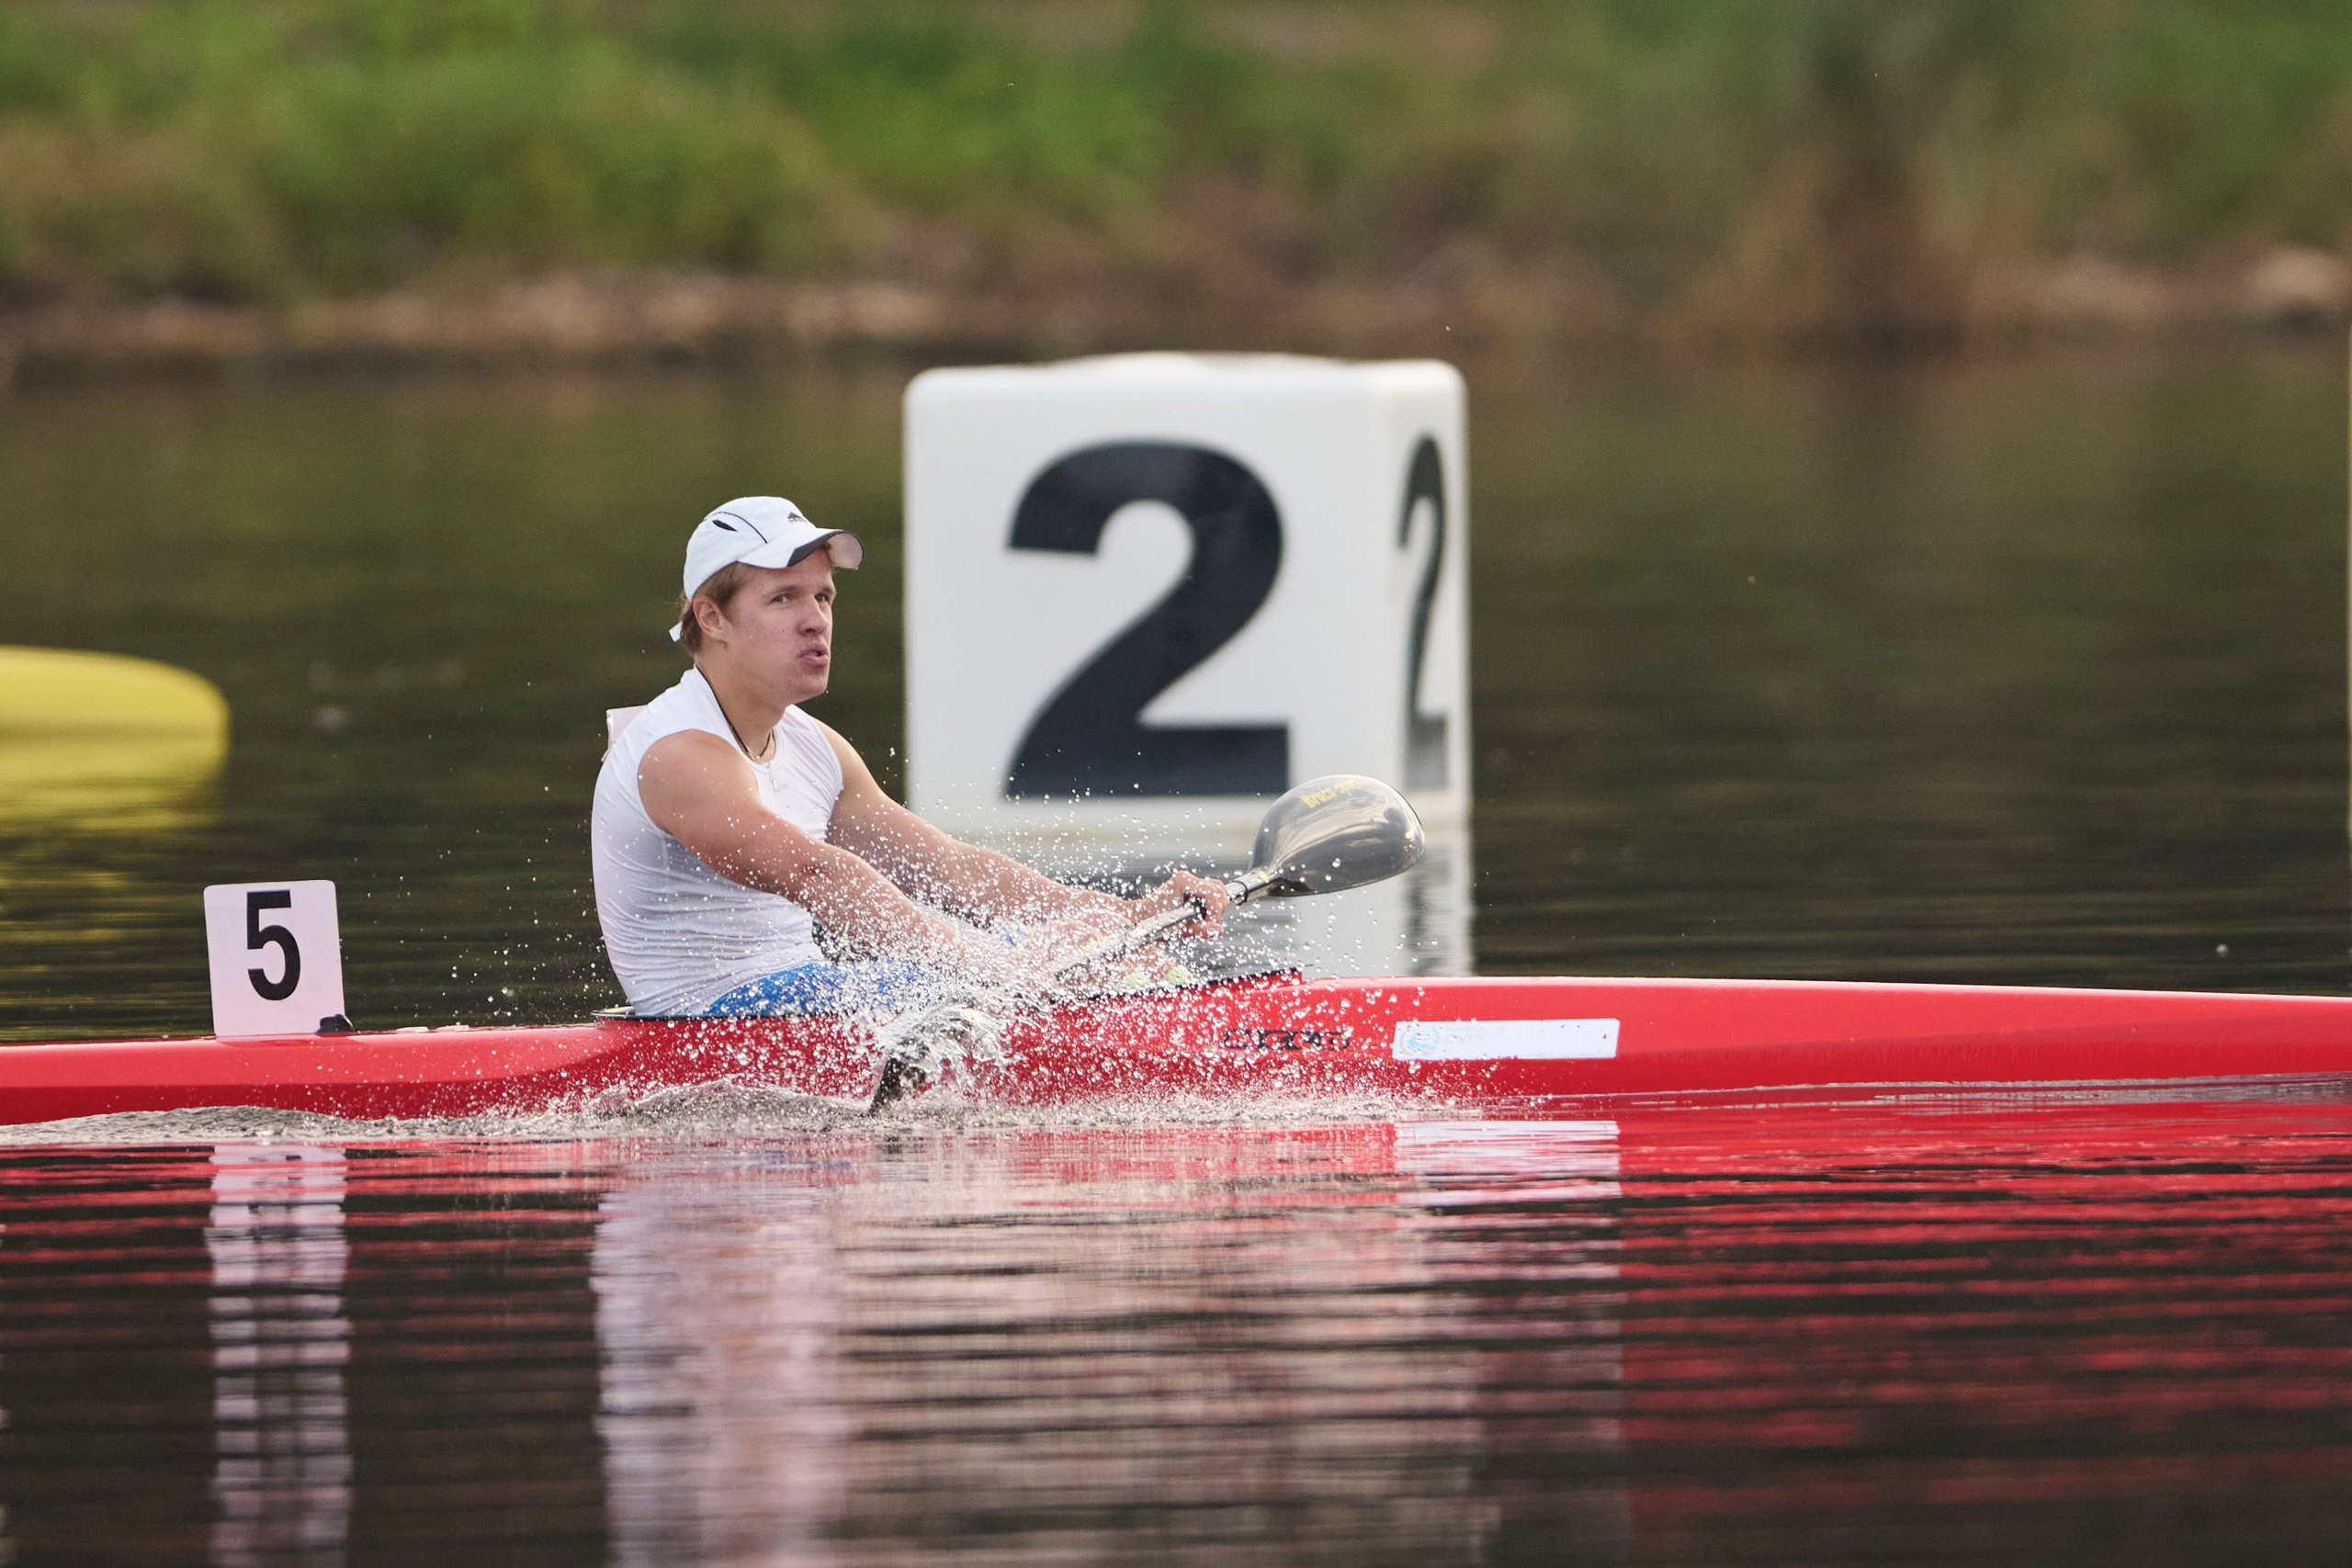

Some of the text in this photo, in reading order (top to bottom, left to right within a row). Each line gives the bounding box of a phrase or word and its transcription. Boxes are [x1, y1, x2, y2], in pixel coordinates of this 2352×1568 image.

[1004, 440, 1290, 797] 2
[1398, 434, 1447, 790] 2
[246, 889, 301, 1000] 5
